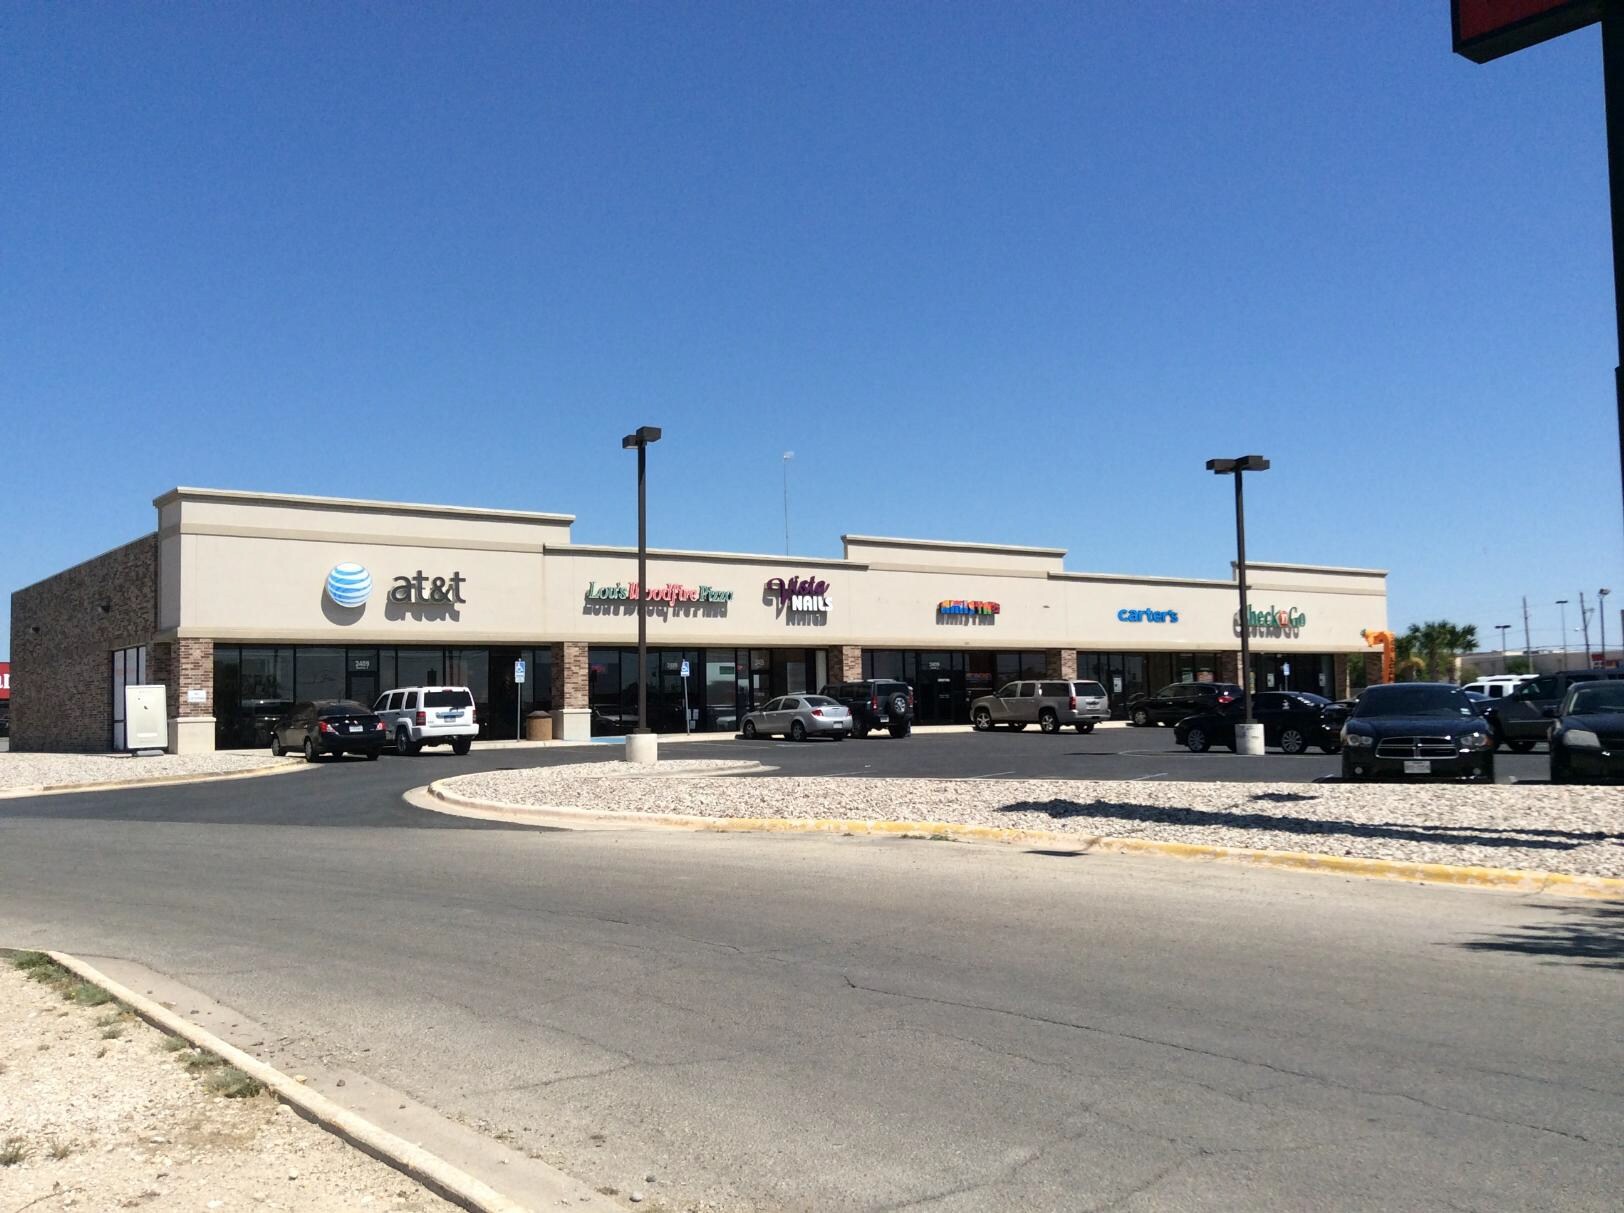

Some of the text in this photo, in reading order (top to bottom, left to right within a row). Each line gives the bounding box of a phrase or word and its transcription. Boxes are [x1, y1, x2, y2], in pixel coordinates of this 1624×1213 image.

[391, 570, 466, 603] at&t
[766, 576, 830, 606] Vista
[792, 595, 833, 611] NAILS
[1117, 608, 1179, 623] carter's
[1245, 604, 1279, 626] heck
[1289, 606, 1306, 628] Go
